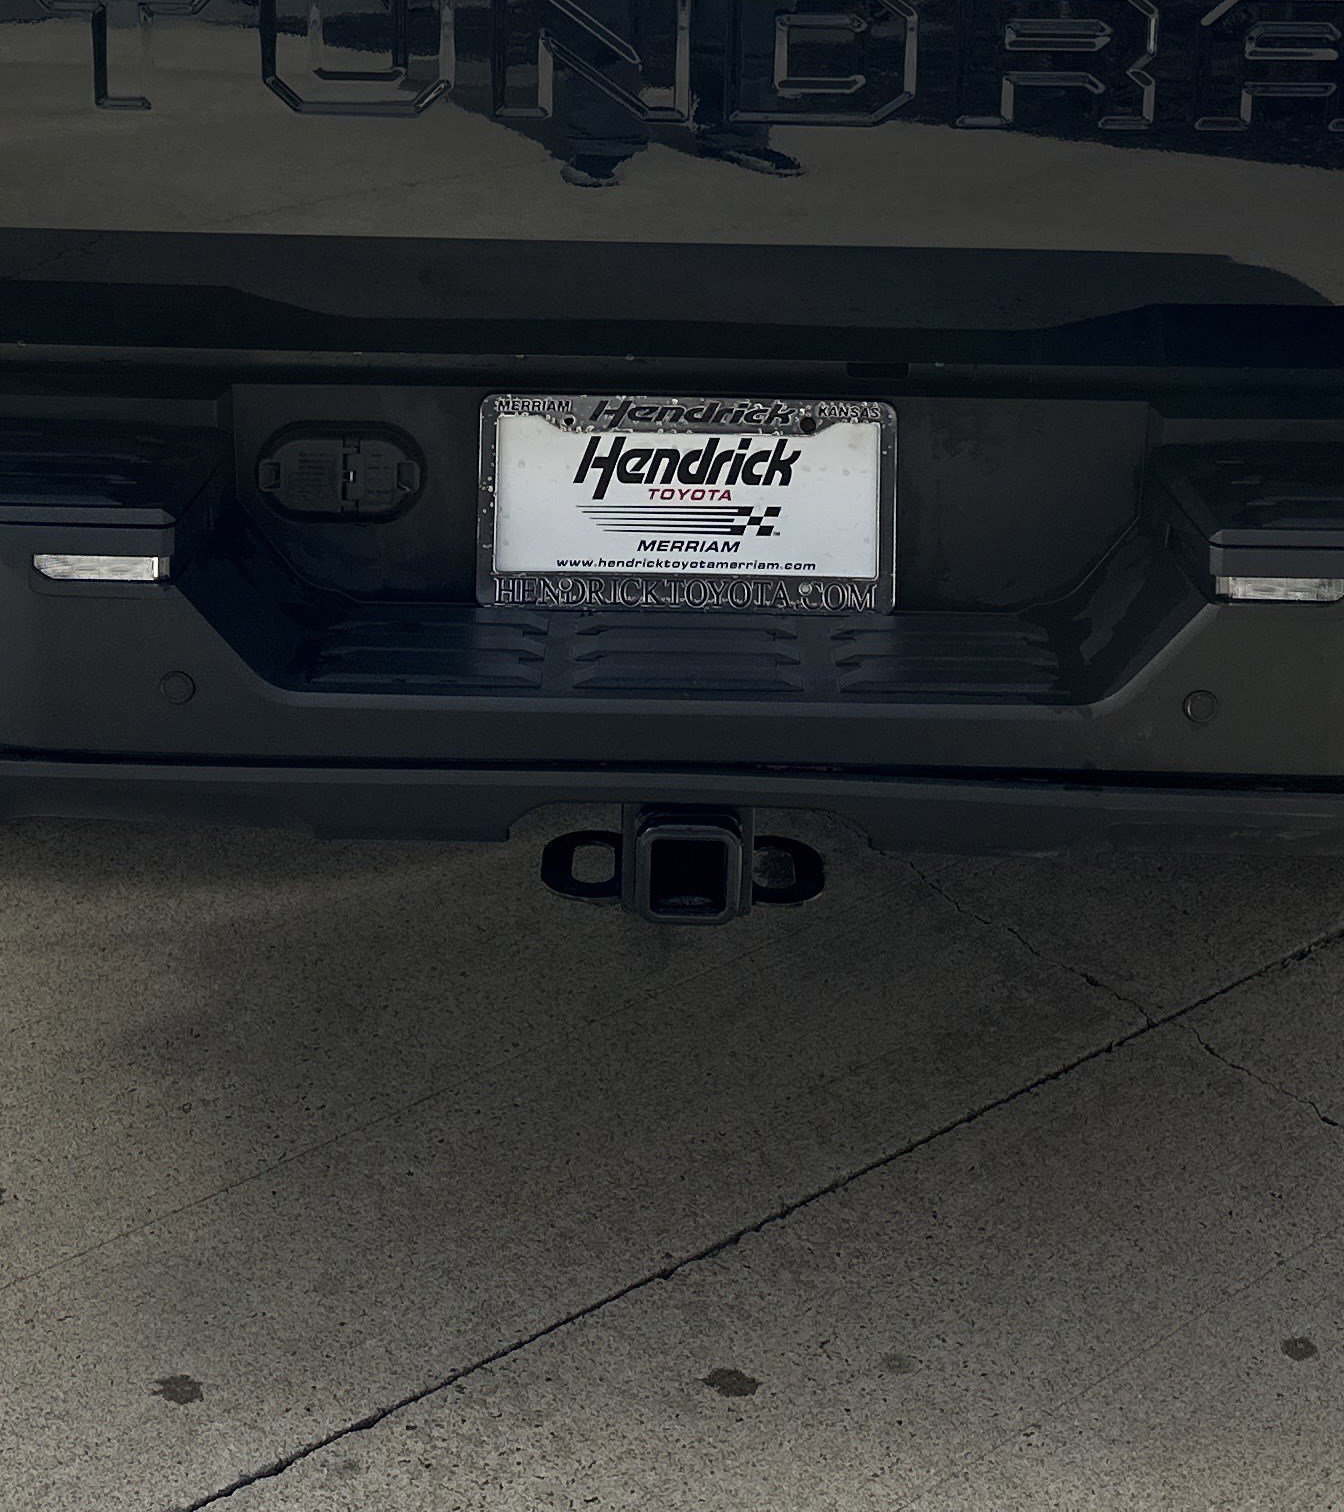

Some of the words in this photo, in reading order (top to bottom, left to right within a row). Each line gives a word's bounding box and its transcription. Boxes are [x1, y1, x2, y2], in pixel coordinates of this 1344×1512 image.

[496, 398, 572, 413] MERRIAM
[817, 404, 882, 419] KANSAS
[589, 399, 797, 430] Hendrick
[572, 435, 802, 500] Hendrick
[648, 488, 732, 501] TOYOTA
[637, 539, 741, 553] MERRIAM
[556, 557, 817, 571] www.hendricktoyotamerriam.com
